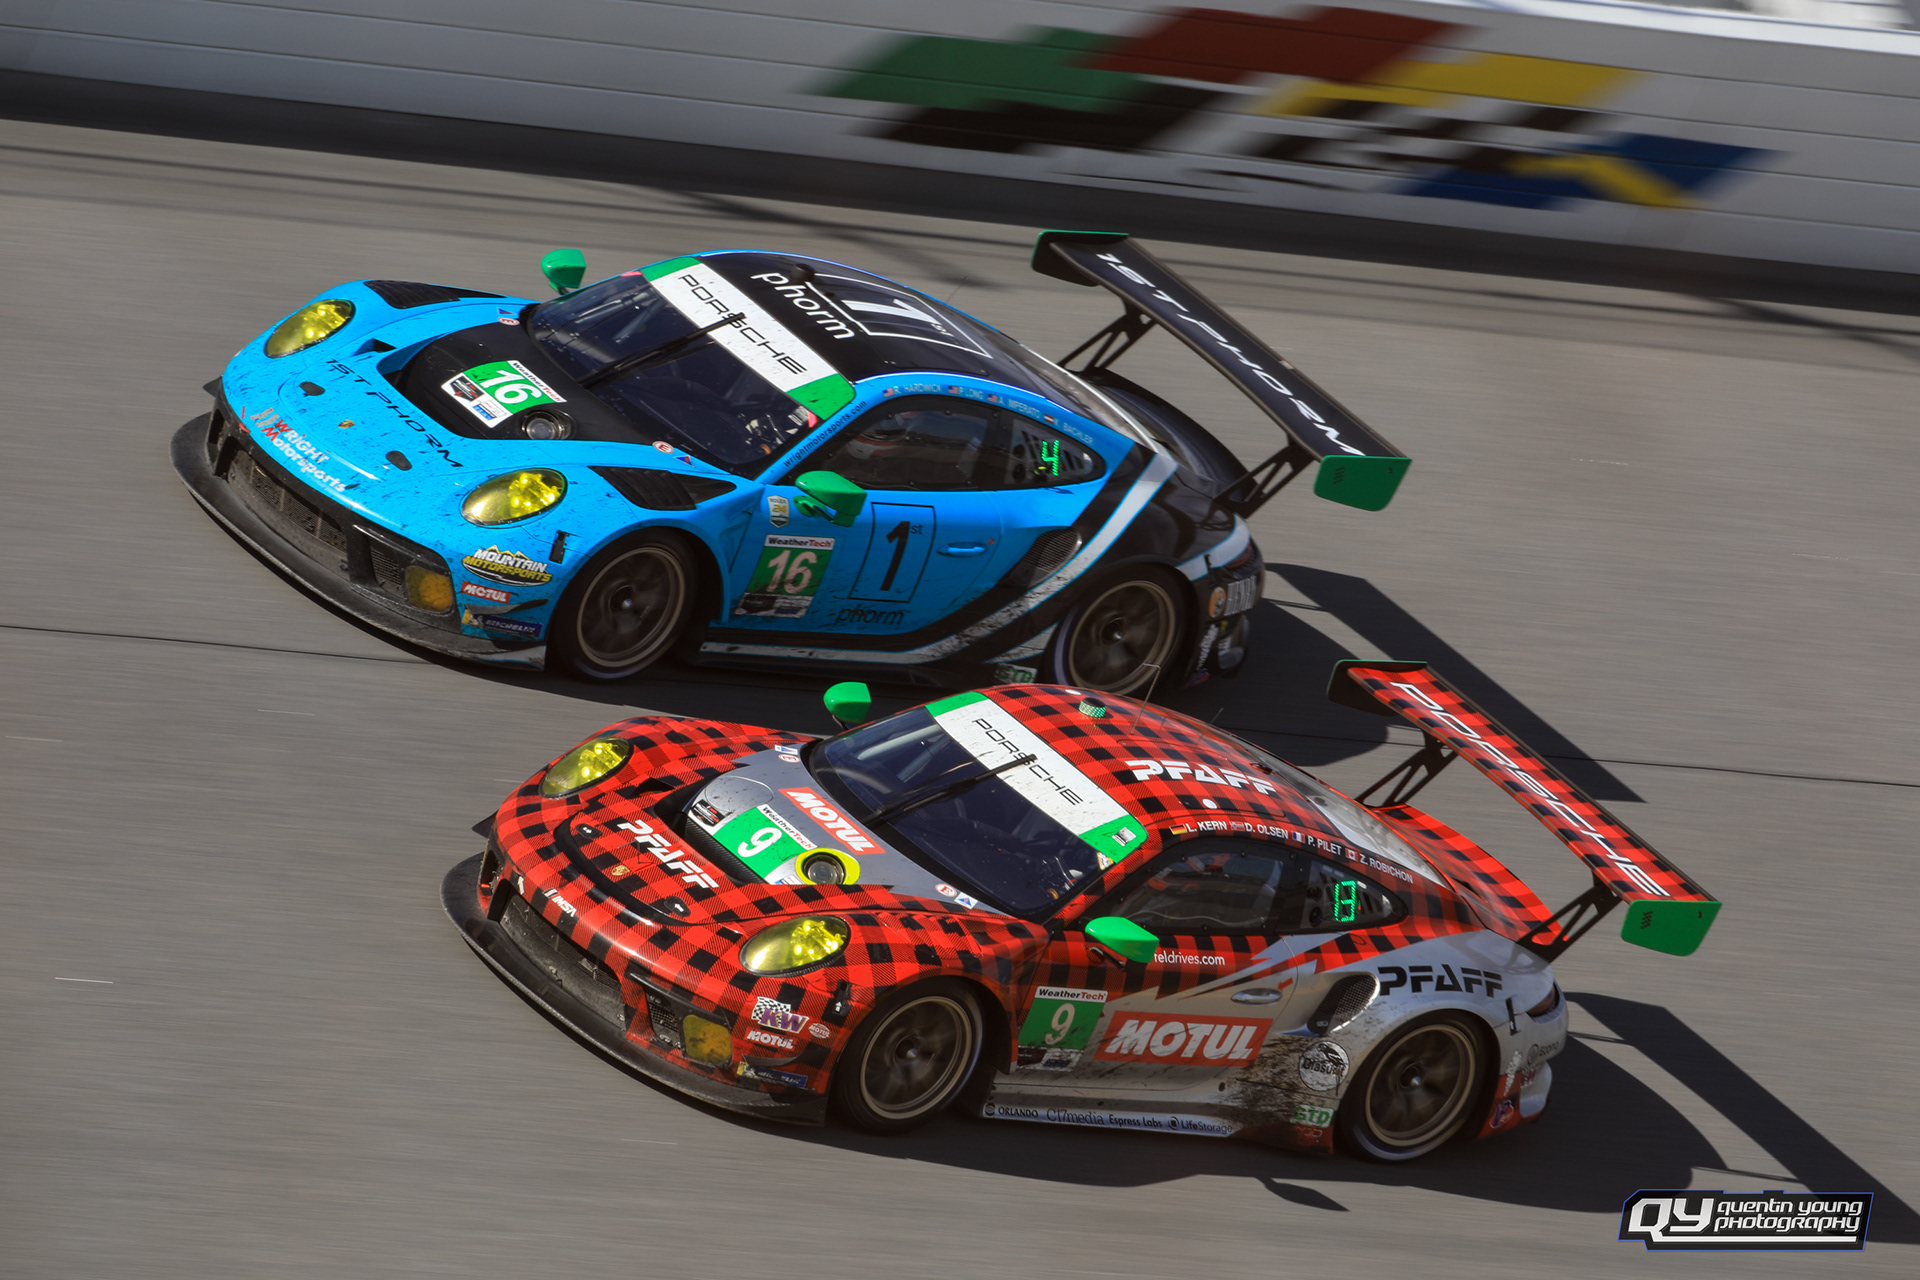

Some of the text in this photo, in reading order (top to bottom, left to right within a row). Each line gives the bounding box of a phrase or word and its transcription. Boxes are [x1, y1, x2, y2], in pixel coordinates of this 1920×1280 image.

[678, 274, 807, 375] PORSCHE
[751, 272, 855, 340] phorm
[1096, 253, 1366, 456] 1ST PHORM
[480, 370, 542, 404] 16
[513, 362, 561, 402] WeatherTech
[326, 358, 463, 467] 1ST PHORM
[784, 400, 867, 467] wrightmotorsports.com
[261, 426, 346, 492] Motorsports
[1041, 440, 1060, 476] 4
[474, 549, 547, 573] MOUNTAIN
[768, 537, 832, 548] WeatherTech
[462, 555, 552, 582] MOTORSPORTS
[767, 550, 817, 594] 16
[463, 584, 507, 602] MOTUL
[835, 604, 904, 625] phorm
[971, 718, 1083, 806] PORSCHE
[1124, 760, 1276, 795] PFAFF
[1390, 681, 1671, 897] PORSCHE
[762, 806, 814, 848] WeatherTech
[786, 791, 875, 852] MOTUL
[617, 819, 719, 889] PFAFF
[737, 827, 783, 857] 9
[1187, 821, 1413, 884] L. KERN D. OLSEN P. PILET Z. ROBICHON
[551, 895, 578, 918] IMSA
[1039, 988, 1105, 1000] WeatherTech
[1377, 963, 1503, 999] PFAFF
[747, 1030, 794, 1049] MOTUL
[759, 1008, 809, 1033] KW
[1045, 1003, 1075, 1045] 9
[1106, 1019, 1257, 1060] MOTUL
[998, 1106, 1039, 1118] ORLANDO
[1109, 1114, 1140, 1127] Espress
[1142, 1116, 1163, 1128] Labs
